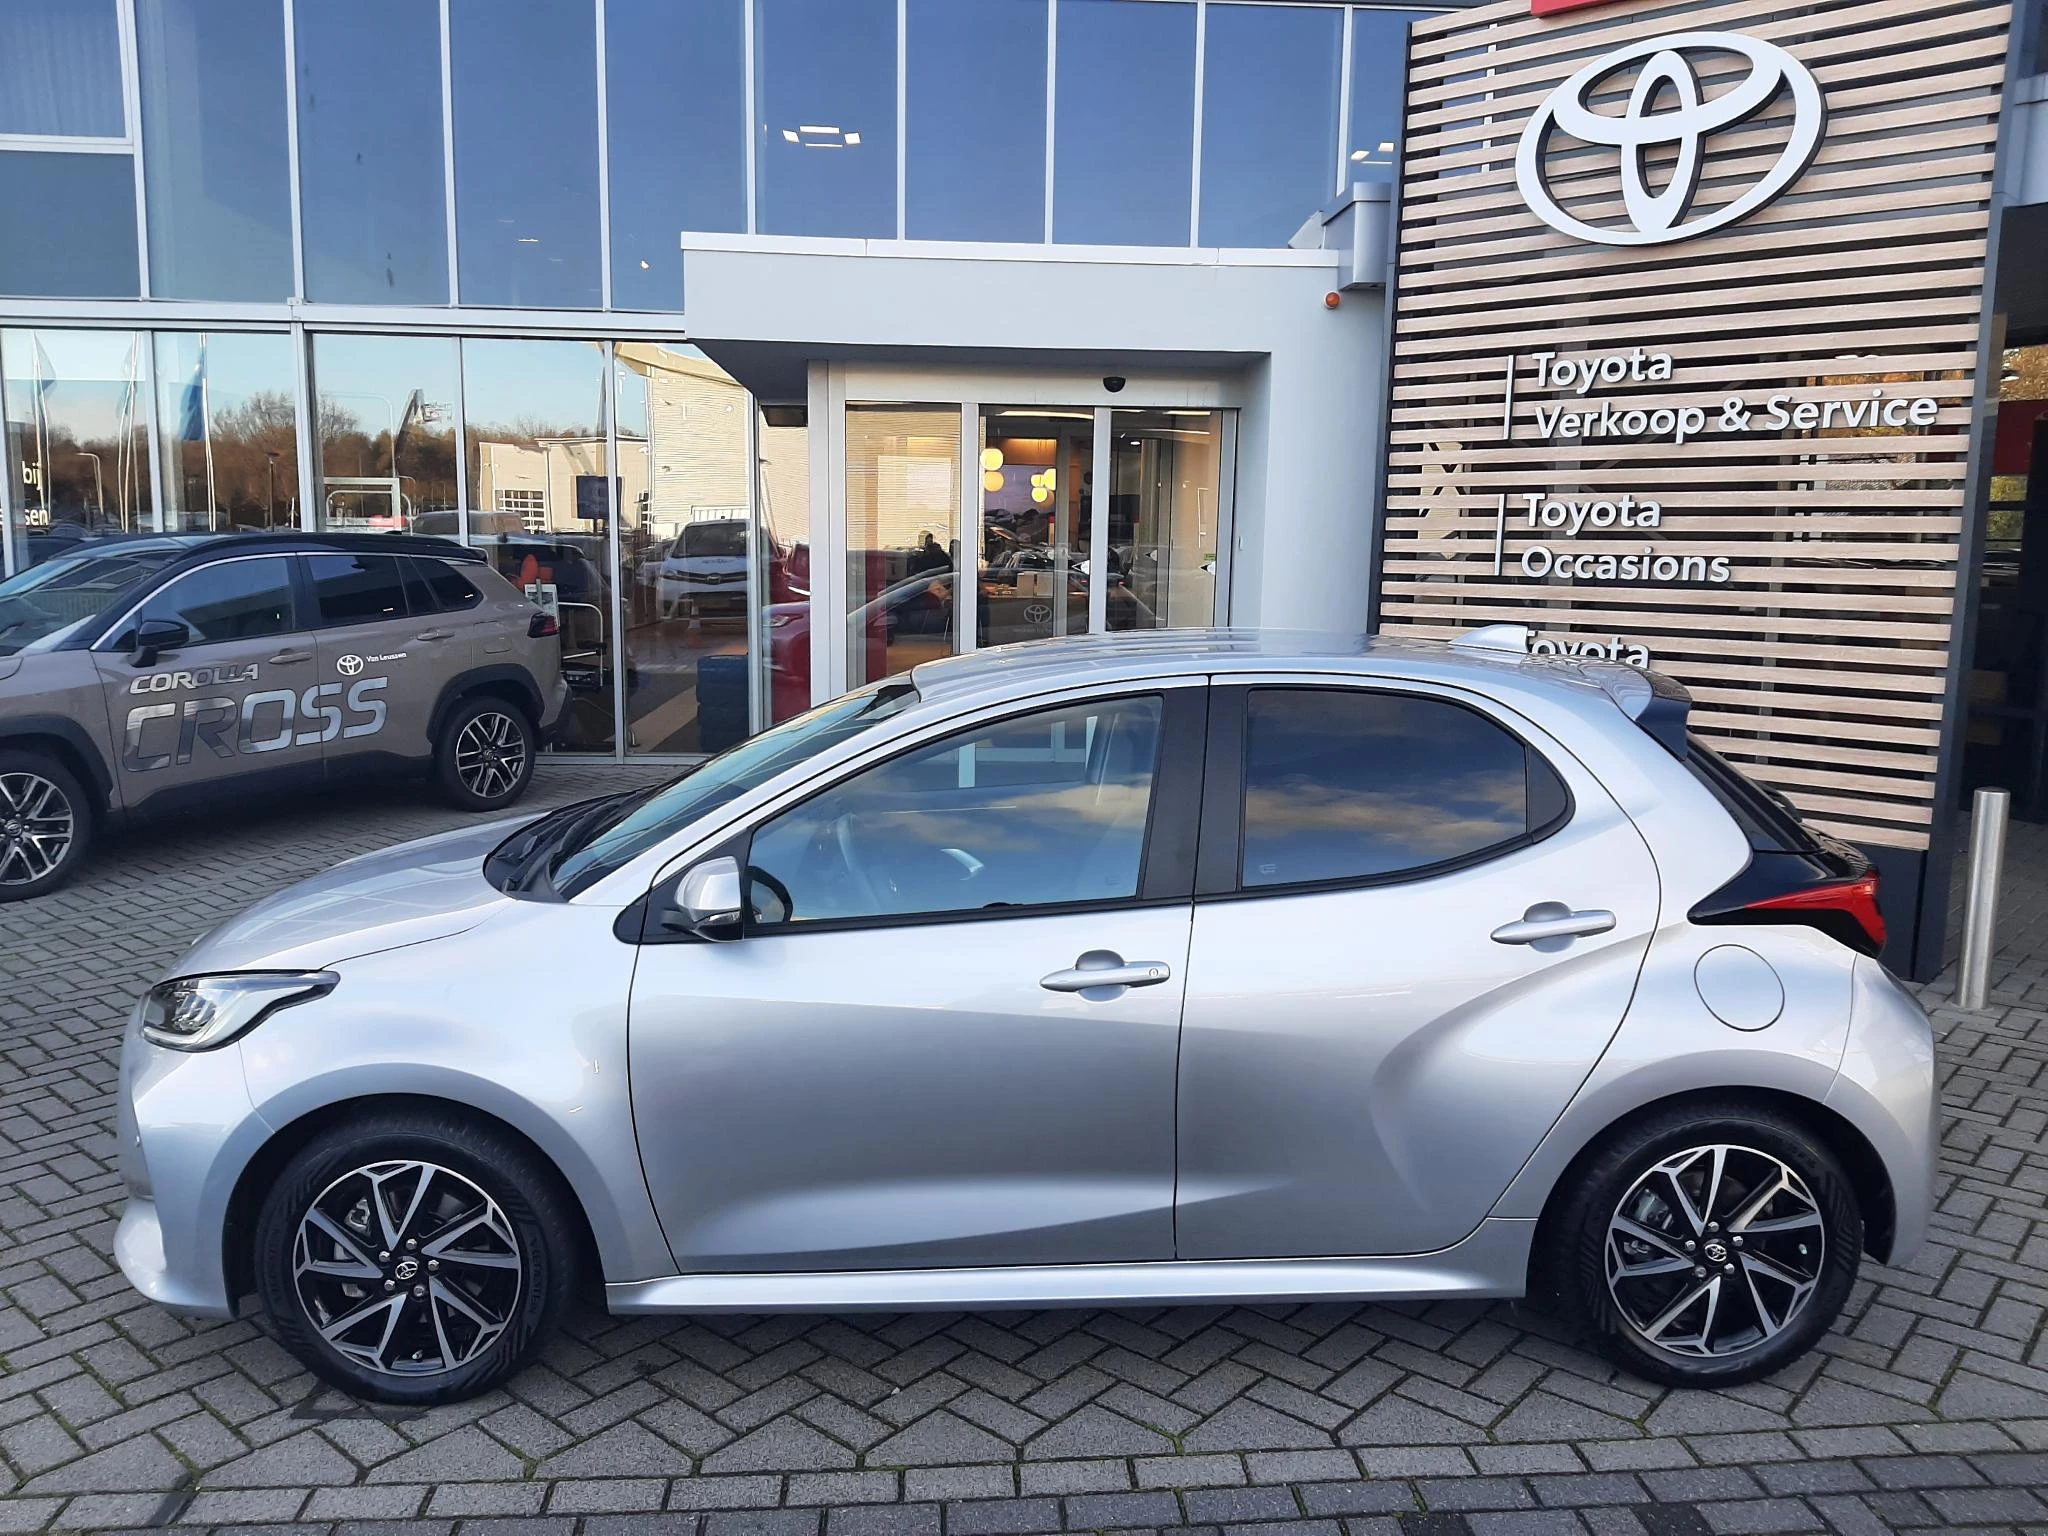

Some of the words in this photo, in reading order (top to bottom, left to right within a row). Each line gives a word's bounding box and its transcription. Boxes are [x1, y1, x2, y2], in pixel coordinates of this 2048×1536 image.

[1531, 348, 1673, 394] Toyota
[1534, 401, 1706, 445] Verkoop
[1717, 396, 1751, 432] &
[1765, 388, 1938, 431] Service
[1521, 493, 1662, 536] Toyota
[1521, 546, 1731, 583] Occasions
[1527, 630, 1650, 669] oota
[129, 663, 260, 694] COROLLA
[122, 676, 389, 773] CROSS
